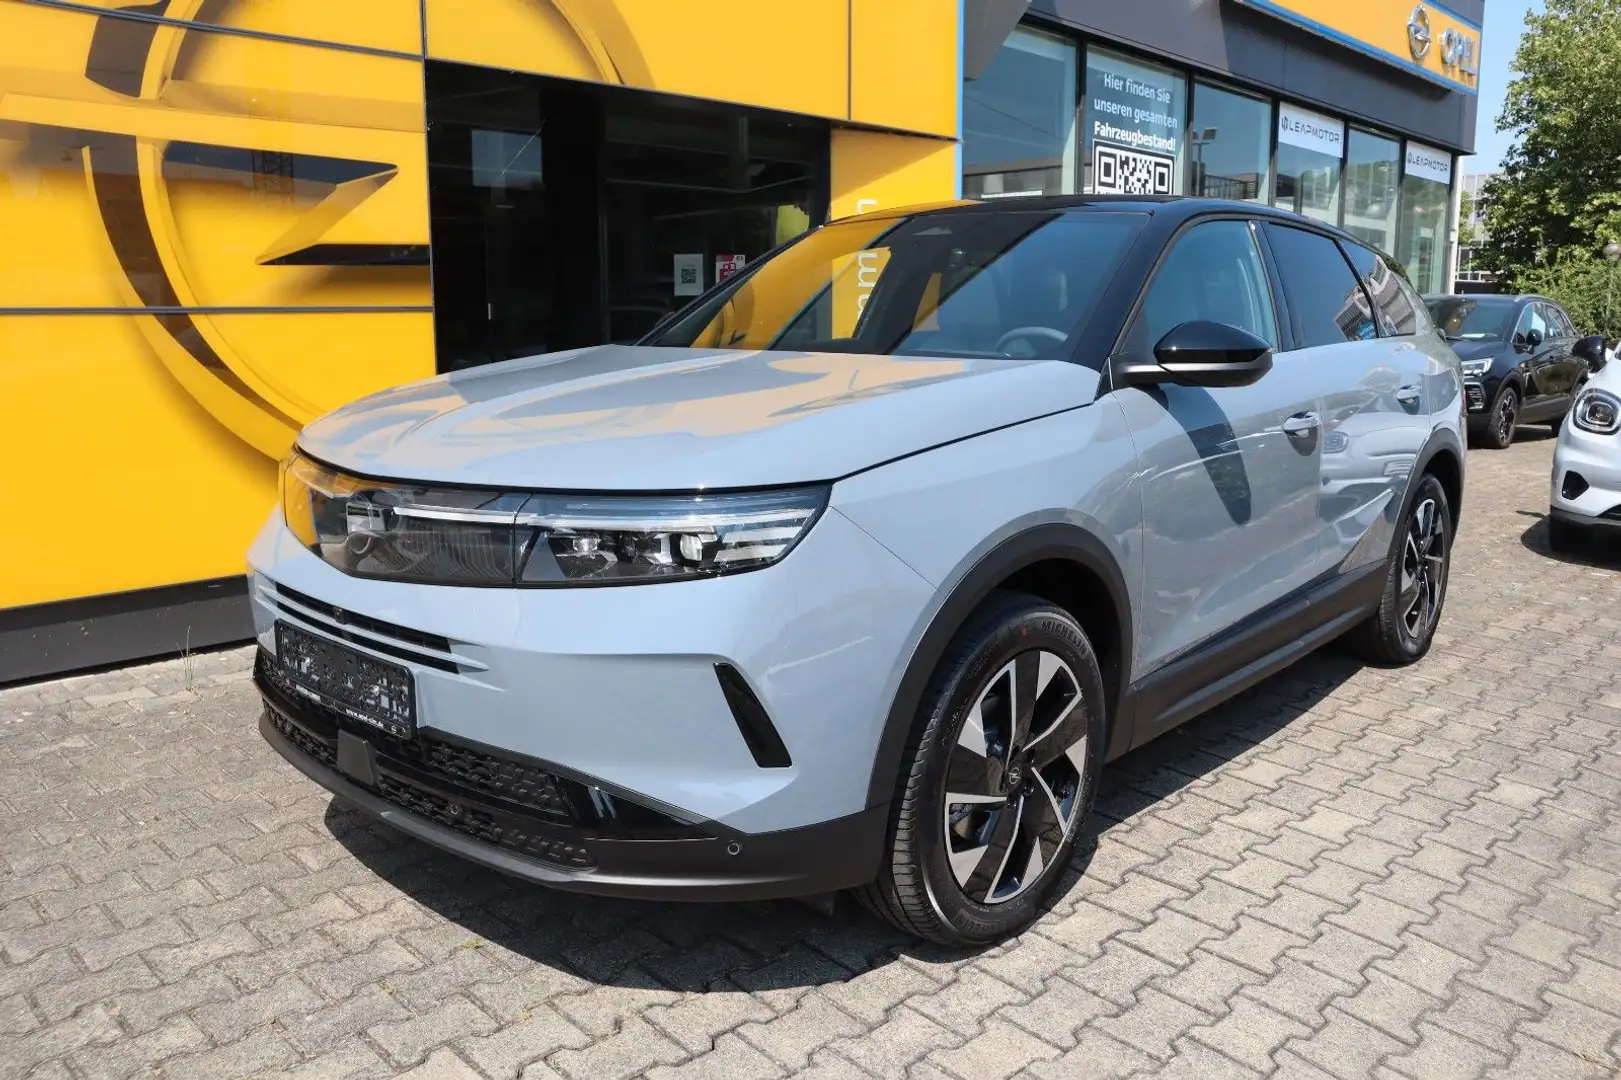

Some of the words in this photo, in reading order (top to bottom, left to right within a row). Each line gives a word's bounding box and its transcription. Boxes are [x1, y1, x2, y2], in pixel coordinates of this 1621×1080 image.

[1104, 74, 1123, 91] Hier
[1126, 78, 1155, 100] finden
[1157, 88, 1171, 104] Sie
[1094, 98, 1132, 118] unseren
[1134, 108, 1178, 129] gesamten
[1094, 120, 1176, 151] Fahrzeugbestand!
[1289, 119, 1340, 144] LEAPMOTOR
[1412, 155, 1448, 172] LEAPMOTOR
[1041, 620, 1088, 655] MICHELIN
